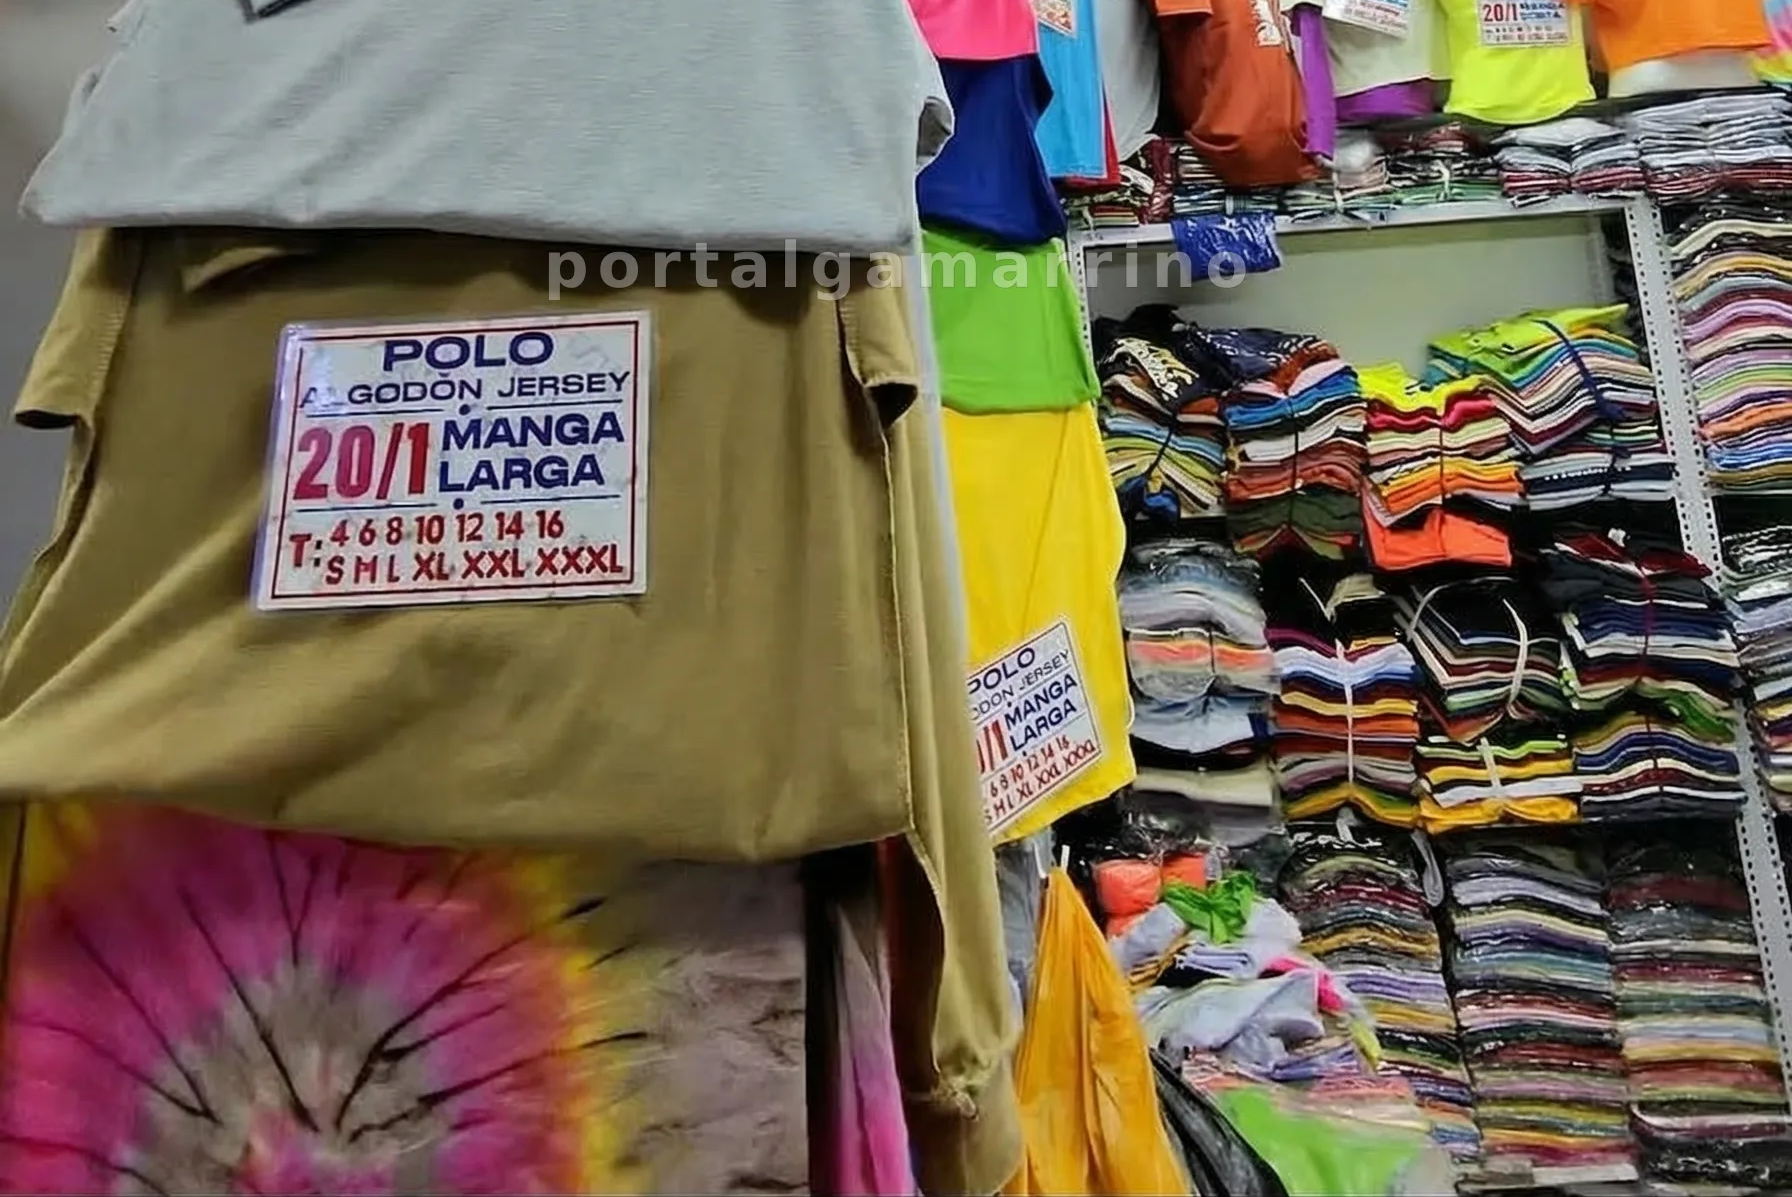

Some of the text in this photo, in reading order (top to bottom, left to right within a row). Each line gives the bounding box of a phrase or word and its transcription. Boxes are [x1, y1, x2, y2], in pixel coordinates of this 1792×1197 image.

[1482, 3, 1518, 22] 20/1
[383, 331, 554, 371] POLO
[497, 371, 630, 398] JERSEY
[293, 411, 624, 501] 20/1 MANGA
[438, 454, 605, 492] LARGA
[330, 509, 565, 547] 4 6 8 10 12 14 16
[325, 555, 346, 585] S
[386, 554, 401, 583] L
[412, 551, 450, 581] XL
[461, 548, 525, 579] XXL
[535, 543, 624, 577] XXXL
[1019, 649, 1069, 690] JERSEY
[1004, 674, 1078, 730] MANGA
[1010, 699, 1077, 751] LARGA
[1010, 764, 1024, 783] 10
[1027, 754, 1040, 772] 12
[1041, 743, 1054, 762] 14
[1056, 735, 1070, 751] 16
[1016, 781, 1034, 802] XL
